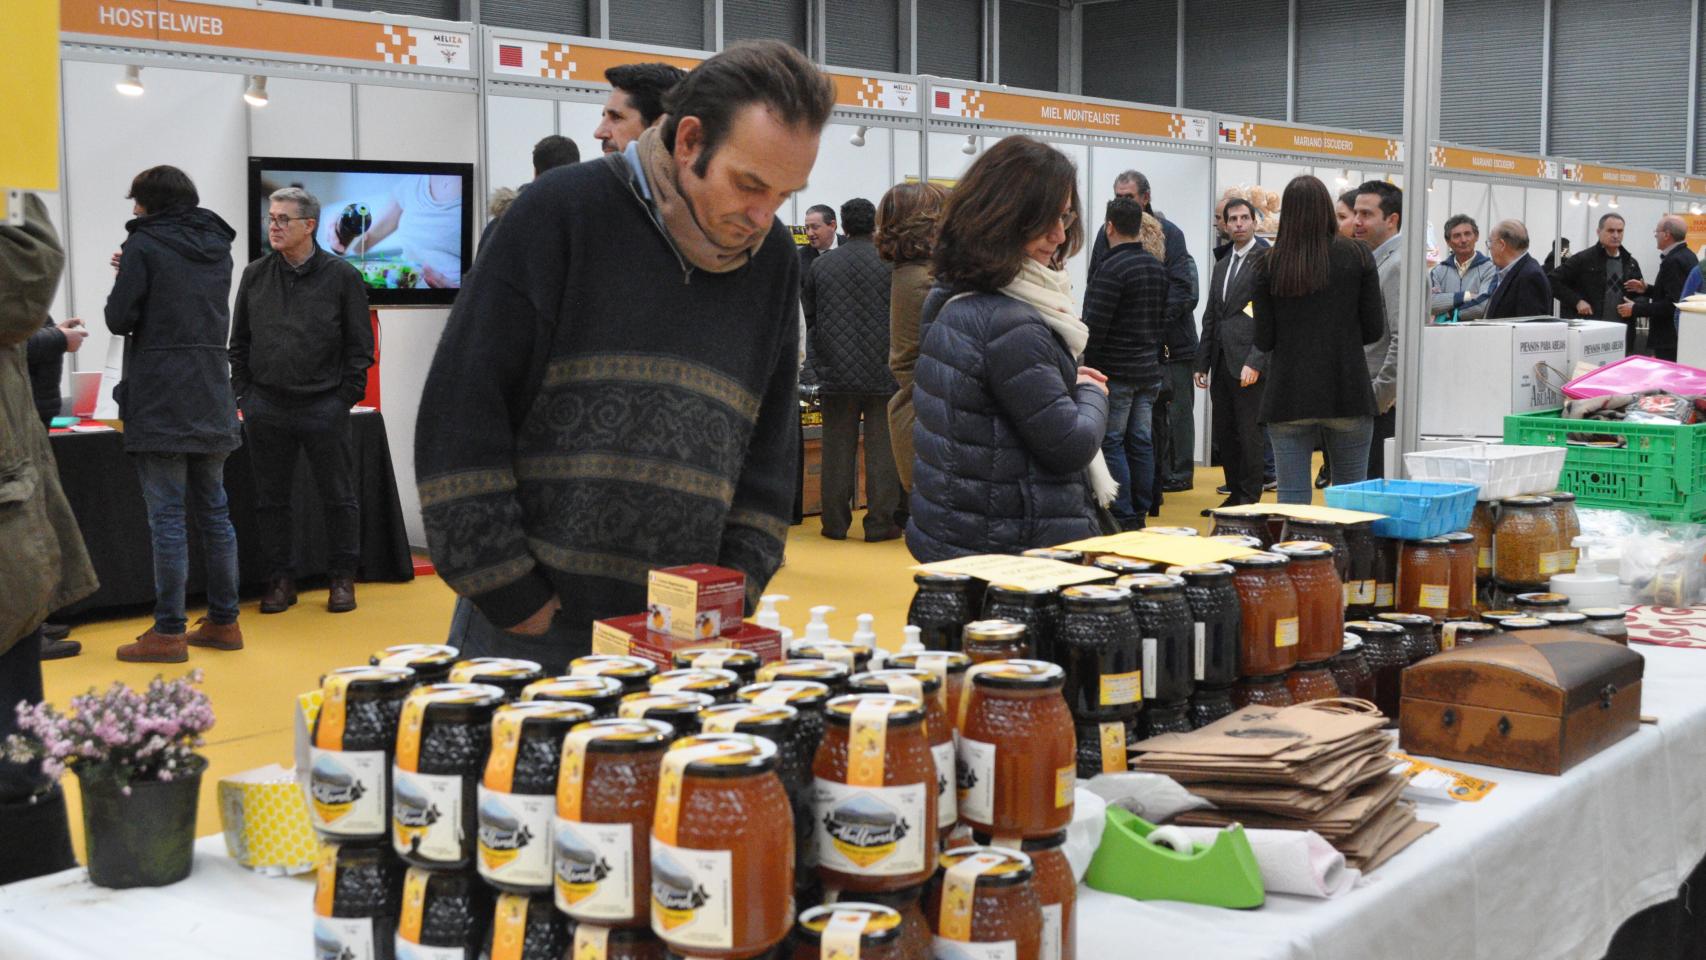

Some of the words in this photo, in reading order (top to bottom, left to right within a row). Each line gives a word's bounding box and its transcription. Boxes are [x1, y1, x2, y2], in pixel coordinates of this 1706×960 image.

[98, 5, 223, 36] HOSTELWEB
[433, 34, 463, 44] MELIZA
[1041, 105, 1062, 120] MIEL
[1063, 108, 1120, 126] MONTEALISTE
[1293, 135, 1323, 148] MARIANO
